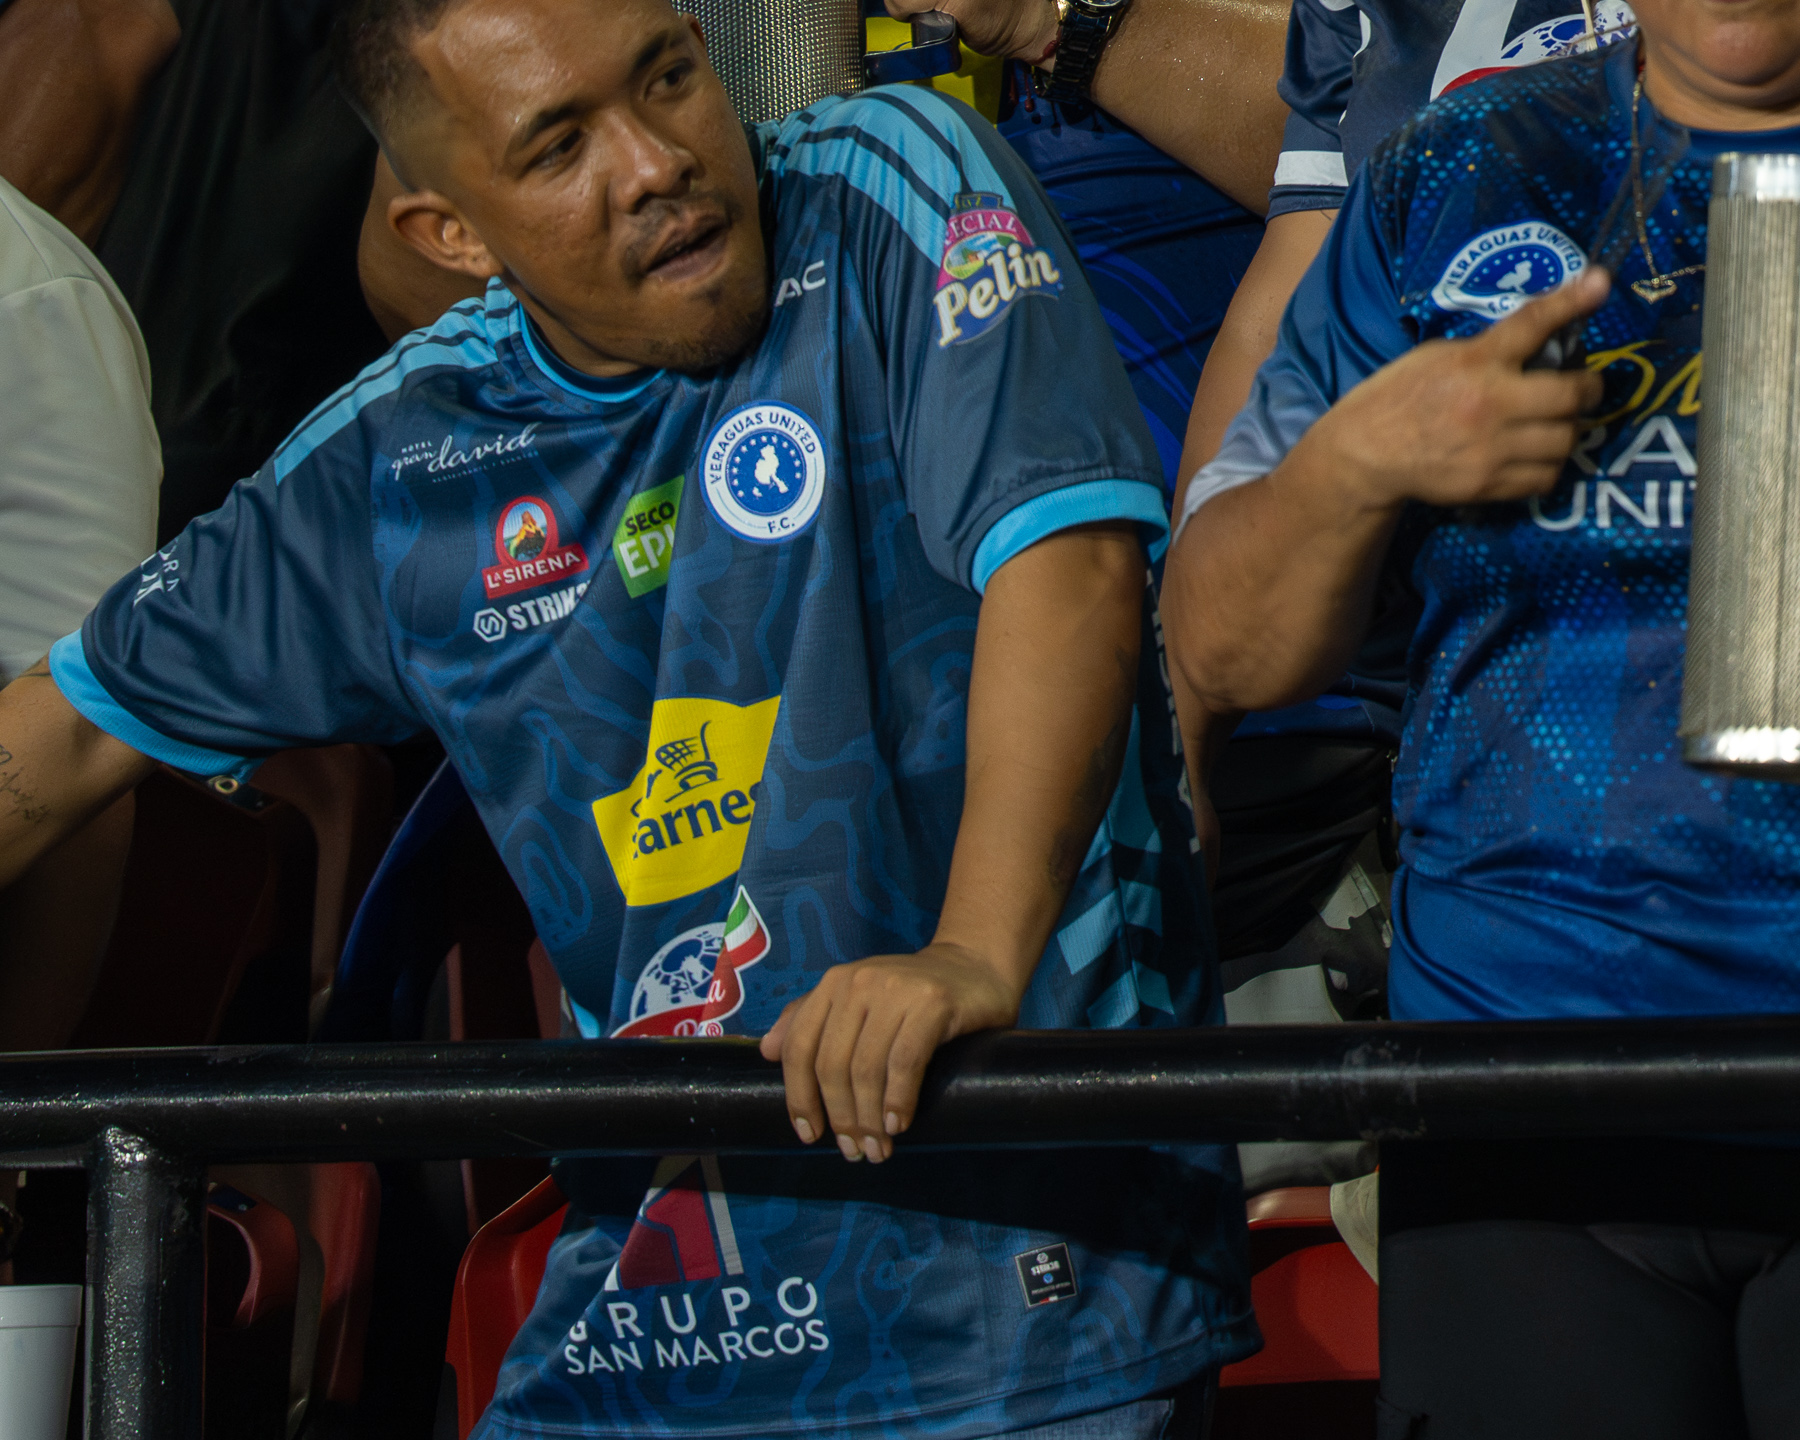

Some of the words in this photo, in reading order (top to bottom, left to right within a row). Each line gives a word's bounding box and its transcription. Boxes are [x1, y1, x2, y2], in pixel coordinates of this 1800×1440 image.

[1447, 227, 1532, 285] ERAGUAS
[933, 243, 1060, 347] Pelin
[392, 450, 438, 481] gran
[427, 421, 543, 472] david
[711, 412, 763, 485] VERAGUAS
[769, 412, 816, 453] UNITED
[625, 501, 675, 536] SECO
[767, 517, 796, 534] F.C.
[1530, 479, 1698, 532] UNI
[503, 551, 581, 584] SIRENA
[507, 579, 591, 631] STRIK
[633, 780, 763, 860] arne
[569, 1276, 818, 1342] GRUPO
[564, 1341, 643, 1375] SAN
[654, 1319, 829, 1368] MARCOS
